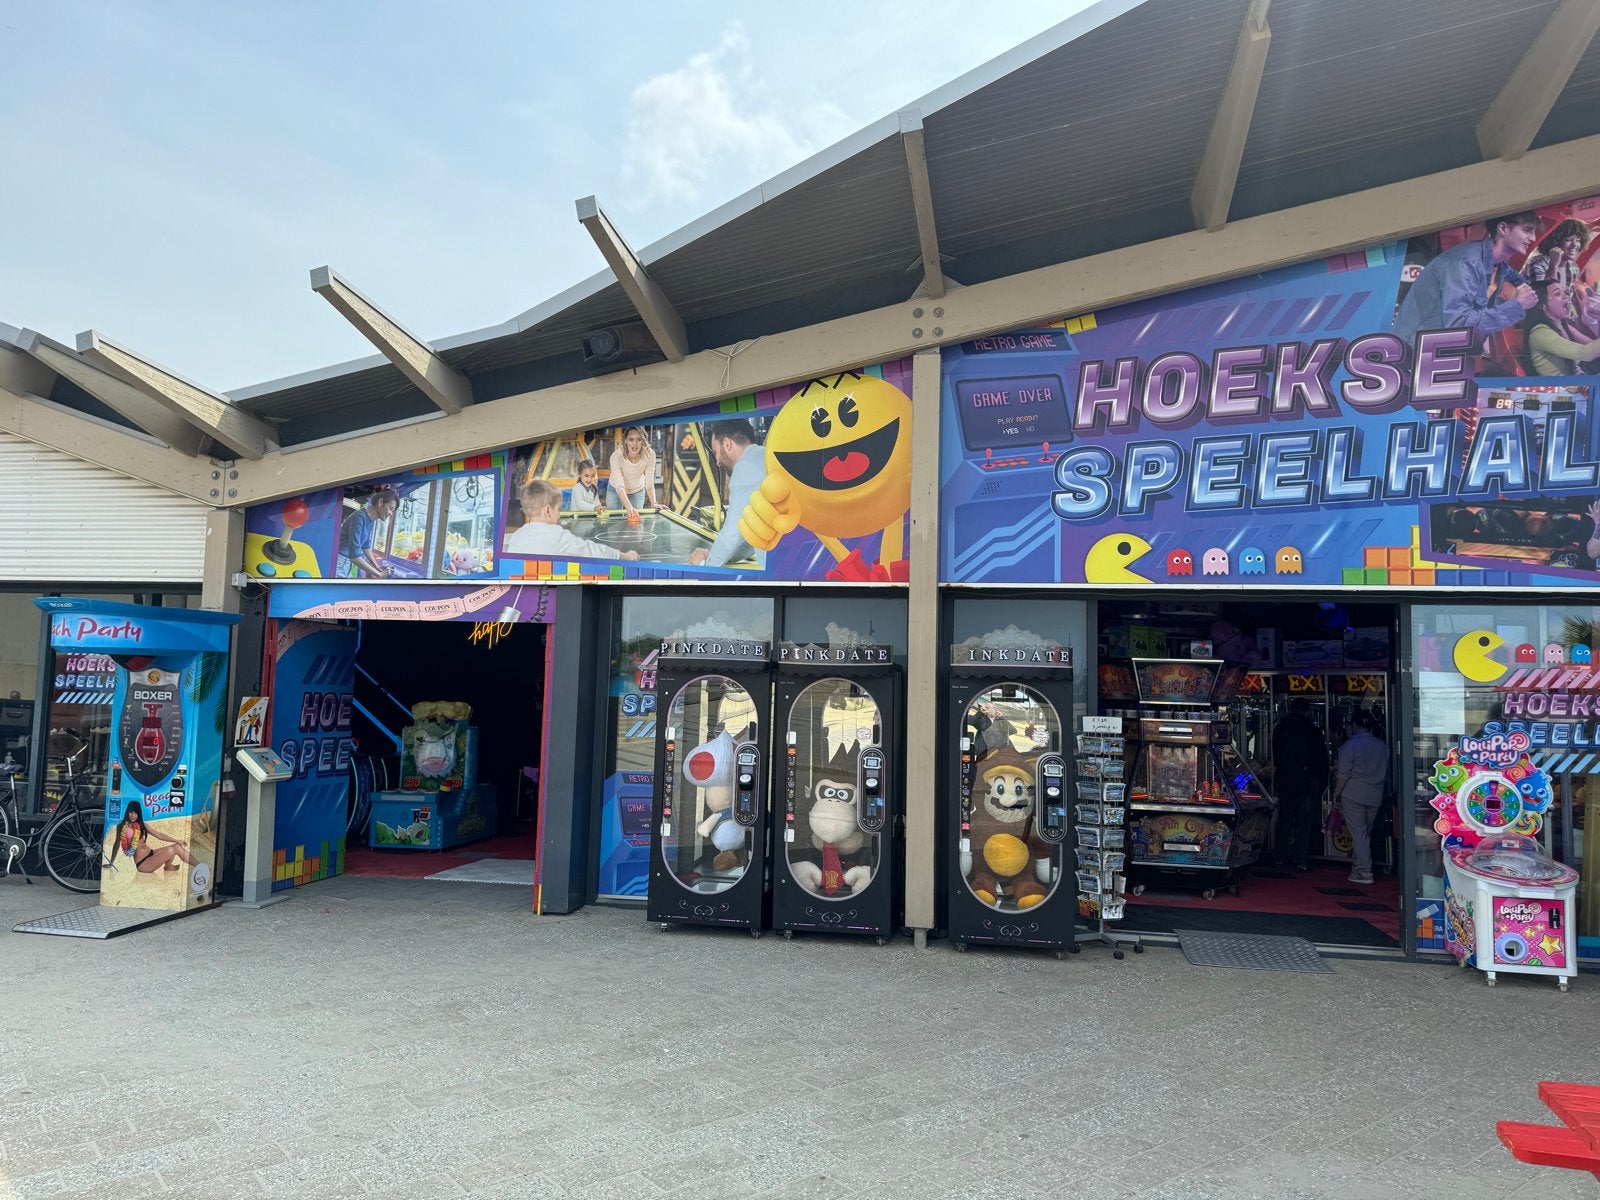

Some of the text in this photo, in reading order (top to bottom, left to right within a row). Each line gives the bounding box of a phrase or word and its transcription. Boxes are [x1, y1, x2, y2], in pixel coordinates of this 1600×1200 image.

[975, 335, 1057, 350] RETRO GAME
[1072, 328, 1475, 432] HOEKSE
[973, 388, 1052, 407] GAME OVER
[1051, 411, 1600, 520] SPEELHAL
[77, 616, 142, 643] Party
[134, 690, 172, 700] BOXER
